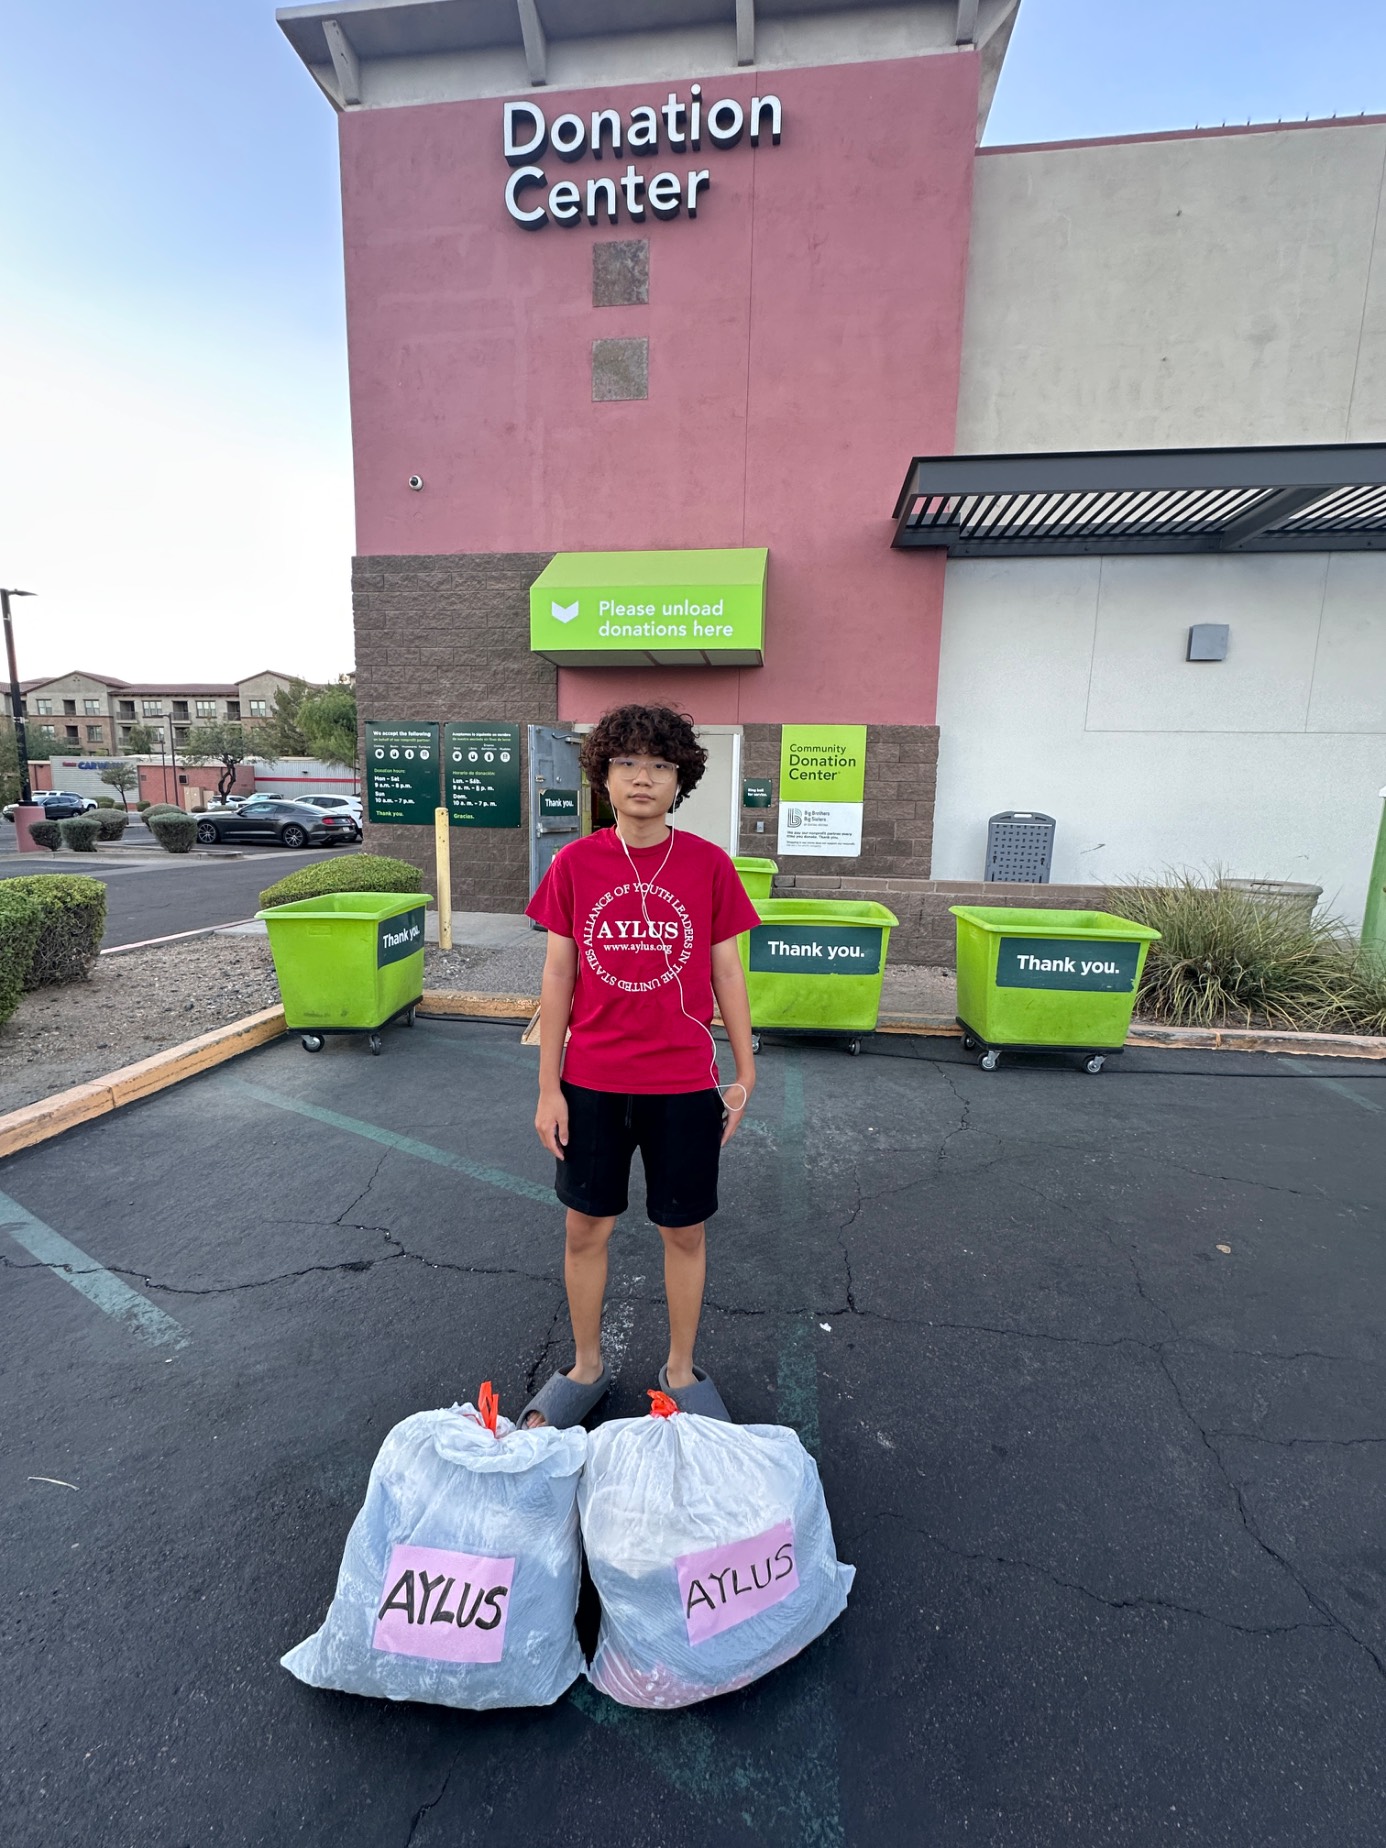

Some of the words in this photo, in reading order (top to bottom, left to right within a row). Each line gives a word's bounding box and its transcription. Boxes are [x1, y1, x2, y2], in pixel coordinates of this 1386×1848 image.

[503, 84, 782, 159] Donation
[504, 165, 710, 225] Center
[599, 600, 656, 617] Please
[662, 599, 724, 617] unload
[598, 621, 687, 637] donations
[693, 620, 734, 637] here
[789, 743, 846, 755] Community
[789, 754, 856, 767] Donation
[789, 768, 838, 780] Center
[545, 798, 562, 807] Thank
[562, 799, 574, 809] you.
[613, 883, 630, 897] OF
[633, 882, 675, 904] YOUTH
[583, 892, 614, 947] ALLIANCE
[596, 920, 679, 939] AYLUS
[671, 899, 694, 949] LEADERS
[382, 928, 409, 949] Thank
[409, 925, 420, 941] you.
[603, 940, 673, 955] www.aylus.org
[767, 940, 823, 957] Thank
[827, 945, 865, 960] you.
[585, 949, 617, 986] STATES
[678, 951, 691, 965] IN
[1016, 954, 1076, 972] Thank
[1080, 961, 1120, 976] you.
[660, 963, 683, 984] THE
[617, 978, 661, 992] UNITED
[686, 1543, 793, 1619] AYLUS
[378, 1568, 508, 1630] AYLUS
